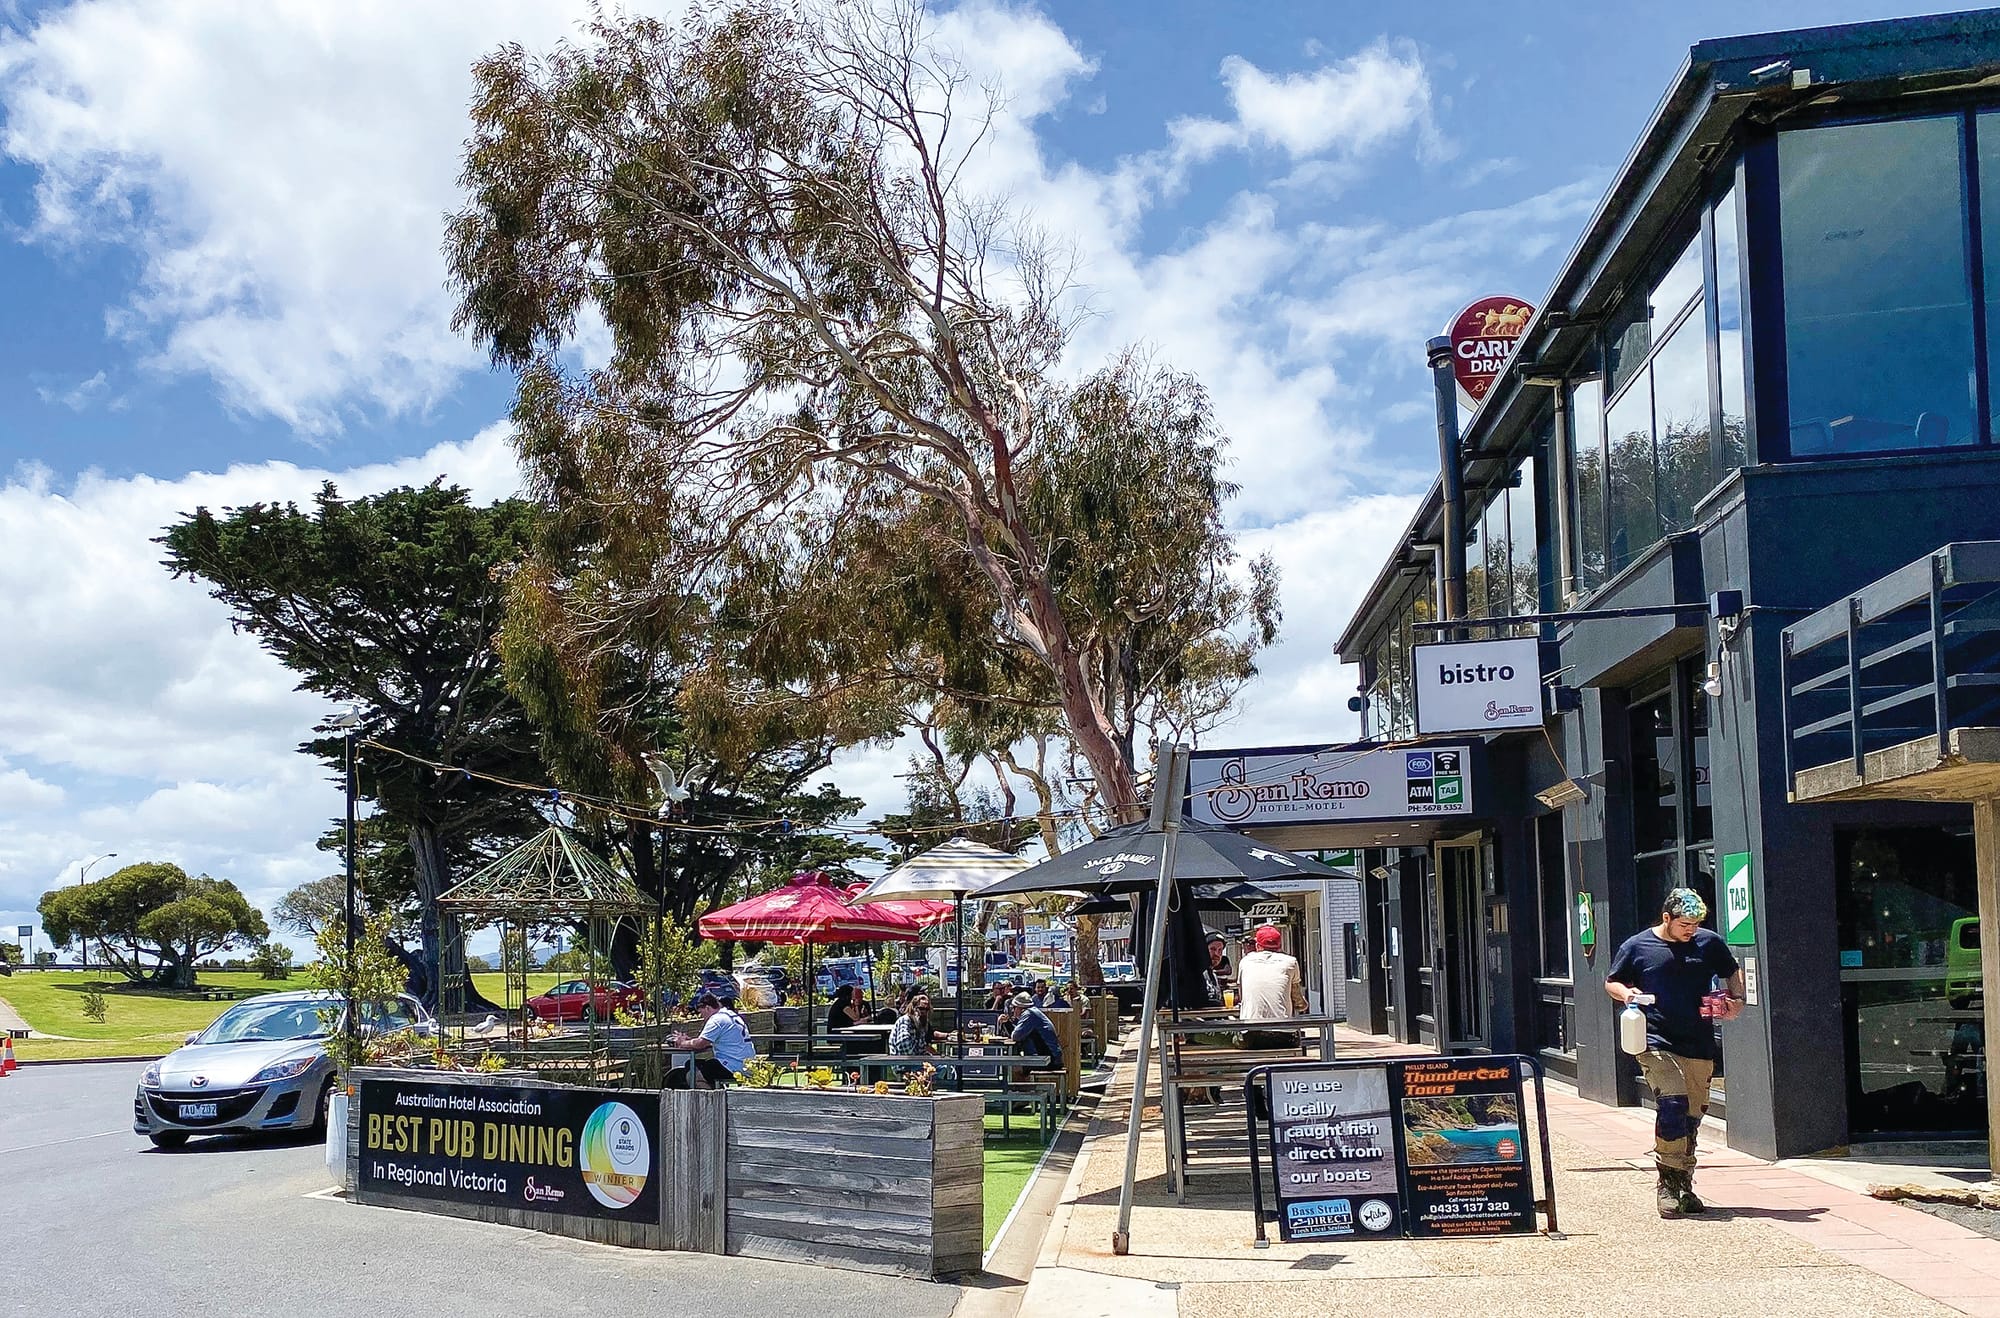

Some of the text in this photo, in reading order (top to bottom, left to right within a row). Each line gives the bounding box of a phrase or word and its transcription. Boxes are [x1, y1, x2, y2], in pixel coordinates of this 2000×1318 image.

[1471, 359, 1504, 372] DRA
[1440, 664, 1514, 685] bistro
[1484, 700, 1510, 721] San
[1208, 757, 1370, 822] San Remo
[1410, 786, 1432, 797] ATM
[1730, 887, 1746, 911] TAB
[1252, 904, 1285, 915] IZZA
[1403, 1067, 1510, 1083] ThunderCat
[1282, 1080, 1342, 1093] We use
[1404, 1084, 1456, 1096] Tours
[395, 1092, 541, 1115] Australian Hotel Association
[1283, 1101, 1336, 1118] locally
[1288, 1121, 1379, 1140] caught fish
[368, 1113, 573, 1168] BEST PUB DINING
[1288, 1145, 1383, 1160] direct from
[373, 1161, 507, 1193] In Regional Victoria
[594, 1174, 634, 1186] WINNER
[1290, 1168, 1372, 1184] our boats
[524, 1176, 565, 1201] San Remo
[1292, 1203, 1348, 1216] Bass Strait
[1430, 1202, 1510, 1213] 0433 137 320
[1307, 1214, 1348, 1225] DIRECT
